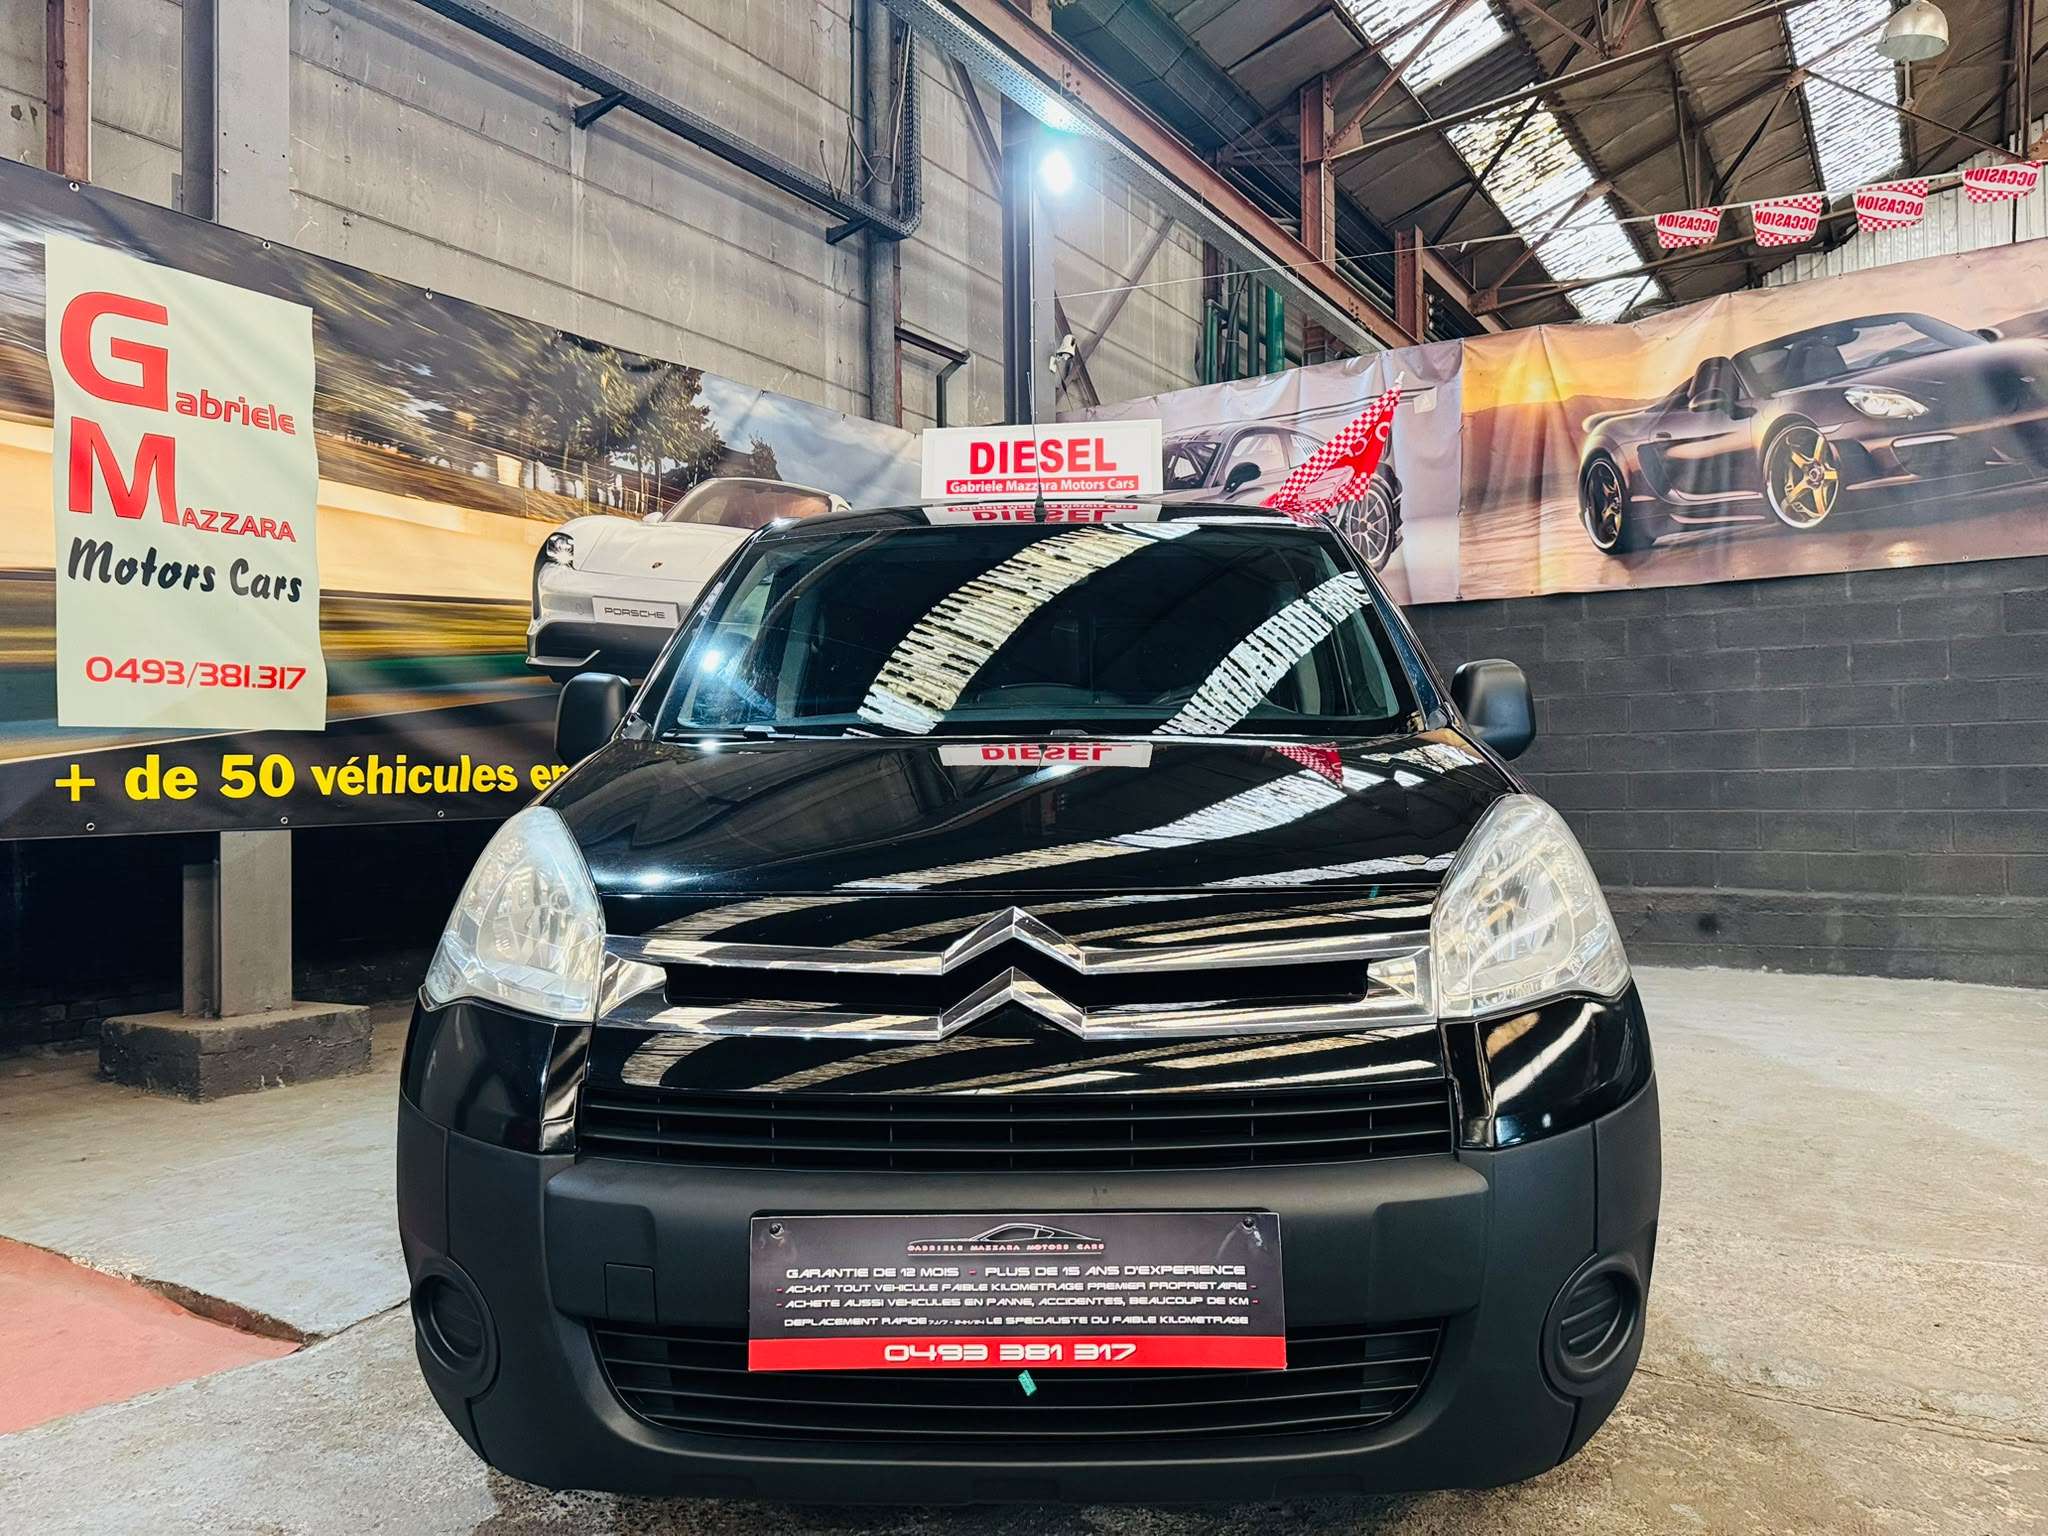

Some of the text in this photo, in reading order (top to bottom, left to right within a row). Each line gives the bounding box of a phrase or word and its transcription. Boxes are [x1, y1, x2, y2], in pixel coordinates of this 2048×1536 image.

[60, 291, 296, 436] Gabriele
[970, 438, 1117, 475] DIESEL
[68, 415, 297, 543] MAZZARA
[950, 480, 1003, 493] Gabriele
[1061, 478, 1105, 491] Motors
[1108, 477, 1135, 490] Cars
[68, 537, 302, 602] Motors Cars
[605, 608, 665, 618] PORSCHE
[86, 656, 305, 689] 0493/381.317
[56, 764, 95, 801] +
[125, 755, 197, 800] de
[220, 754, 295, 798] 50
[311, 755, 518, 795] véhicules
[786, 1268, 868, 1278] GARANTIE
[873, 1268, 896, 1277] DE
[900, 1268, 915, 1276] 12
[920, 1267, 959, 1276] MOIS
[985, 1267, 1030, 1276] PLUS
[1035, 1267, 1058, 1276] DE
[1062, 1267, 1080, 1275] 15
[1085, 1266, 1119, 1275] ANS
[1124, 1265, 1245, 1275] D'EXPERIENCE
[786, 1285, 830, 1293] ACHAT
[834, 1284, 871, 1292] TOUT
[874, 1282, 938, 1292] VEHICULE
[942, 1283, 988, 1291] FAIBLE
[991, 1283, 1083, 1291] KILOMETRAGE
[1087, 1282, 1146, 1290] PREMIER
[1149, 1282, 1247, 1290] PROPRIETAIRE
[785, 1300, 840, 1308] ACHETE
[844, 1299, 884, 1307] AUSSI
[964, 1298, 983, 1306] EN
[986, 1298, 1034, 1307] PANNE,
[1038, 1297, 1125, 1306] ACCIDENTES,
[1229, 1297, 1248, 1305] KM
[785, 1318, 878, 1326] DEPLACEMENT
[1160, 1316, 1248, 1324] KILOMETRAGE
[885, 1344, 1135, 1360] 0493 381 317
